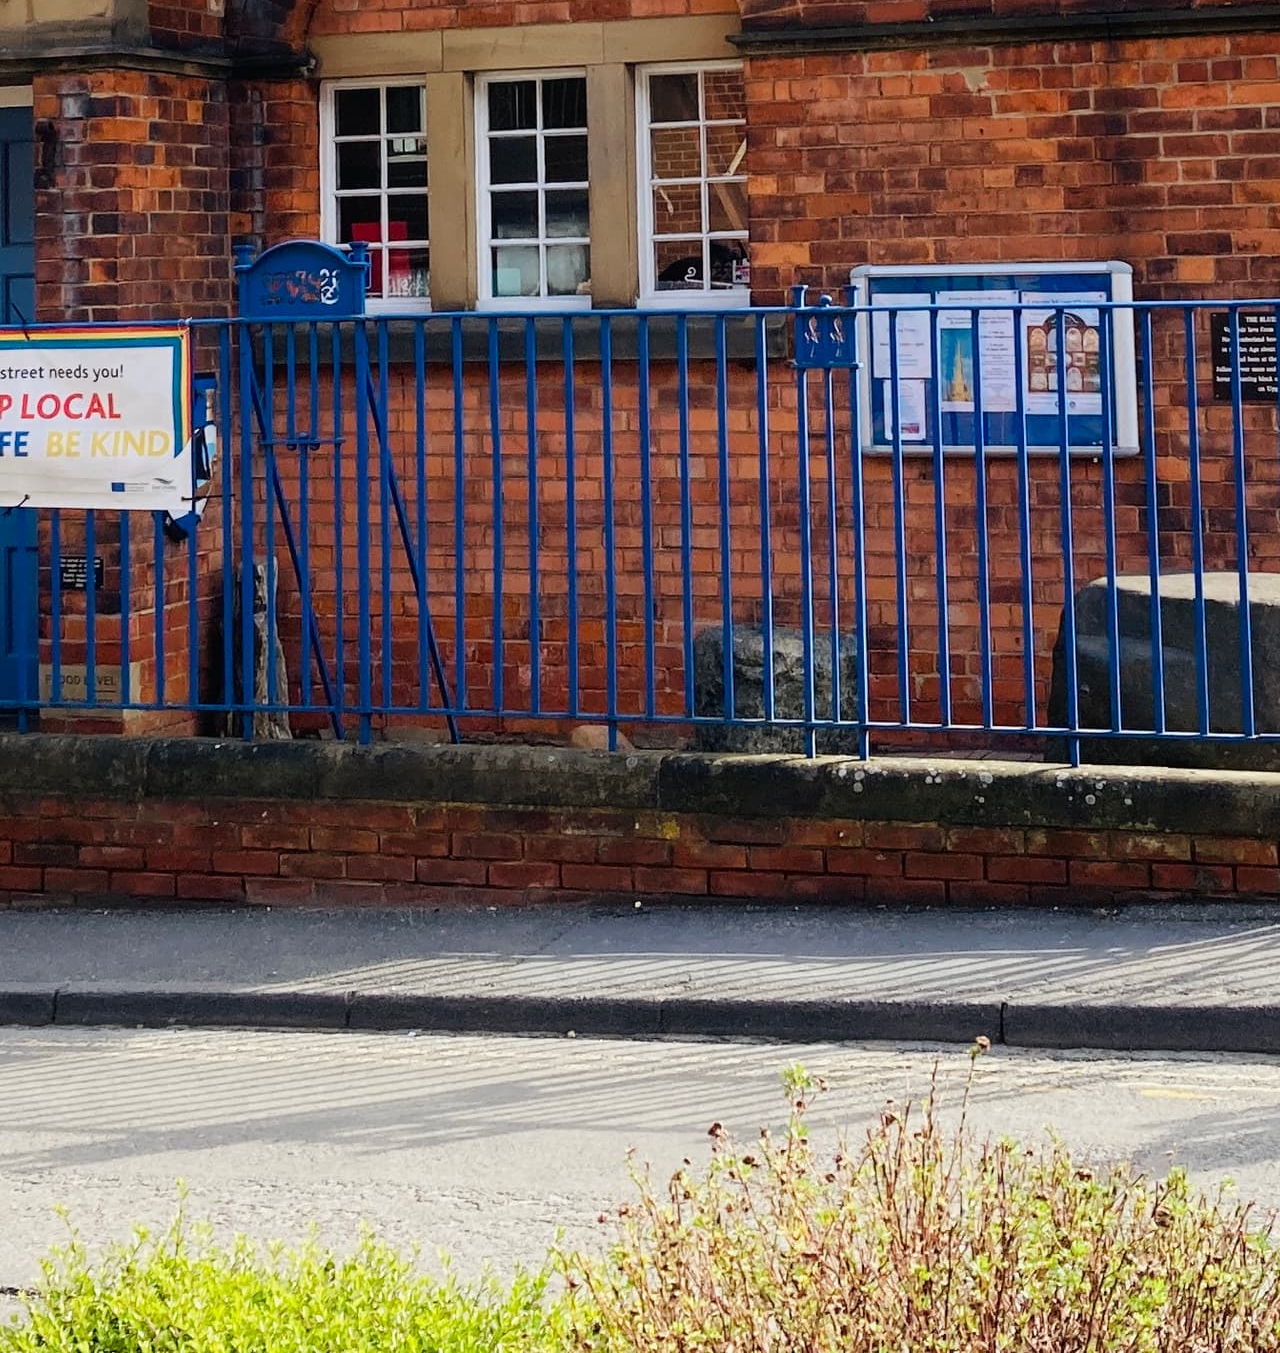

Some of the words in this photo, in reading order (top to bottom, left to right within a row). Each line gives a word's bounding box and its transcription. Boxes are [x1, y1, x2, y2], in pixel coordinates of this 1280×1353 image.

[0, 366, 45, 381] street
[48, 363, 89, 380] needs
[92, 363, 124, 383] you!
[20, 392, 122, 420] LOCAL
[46, 429, 81, 458] BE
[90, 429, 171, 457] KIND
[44, 674, 81, 685] FOOD
